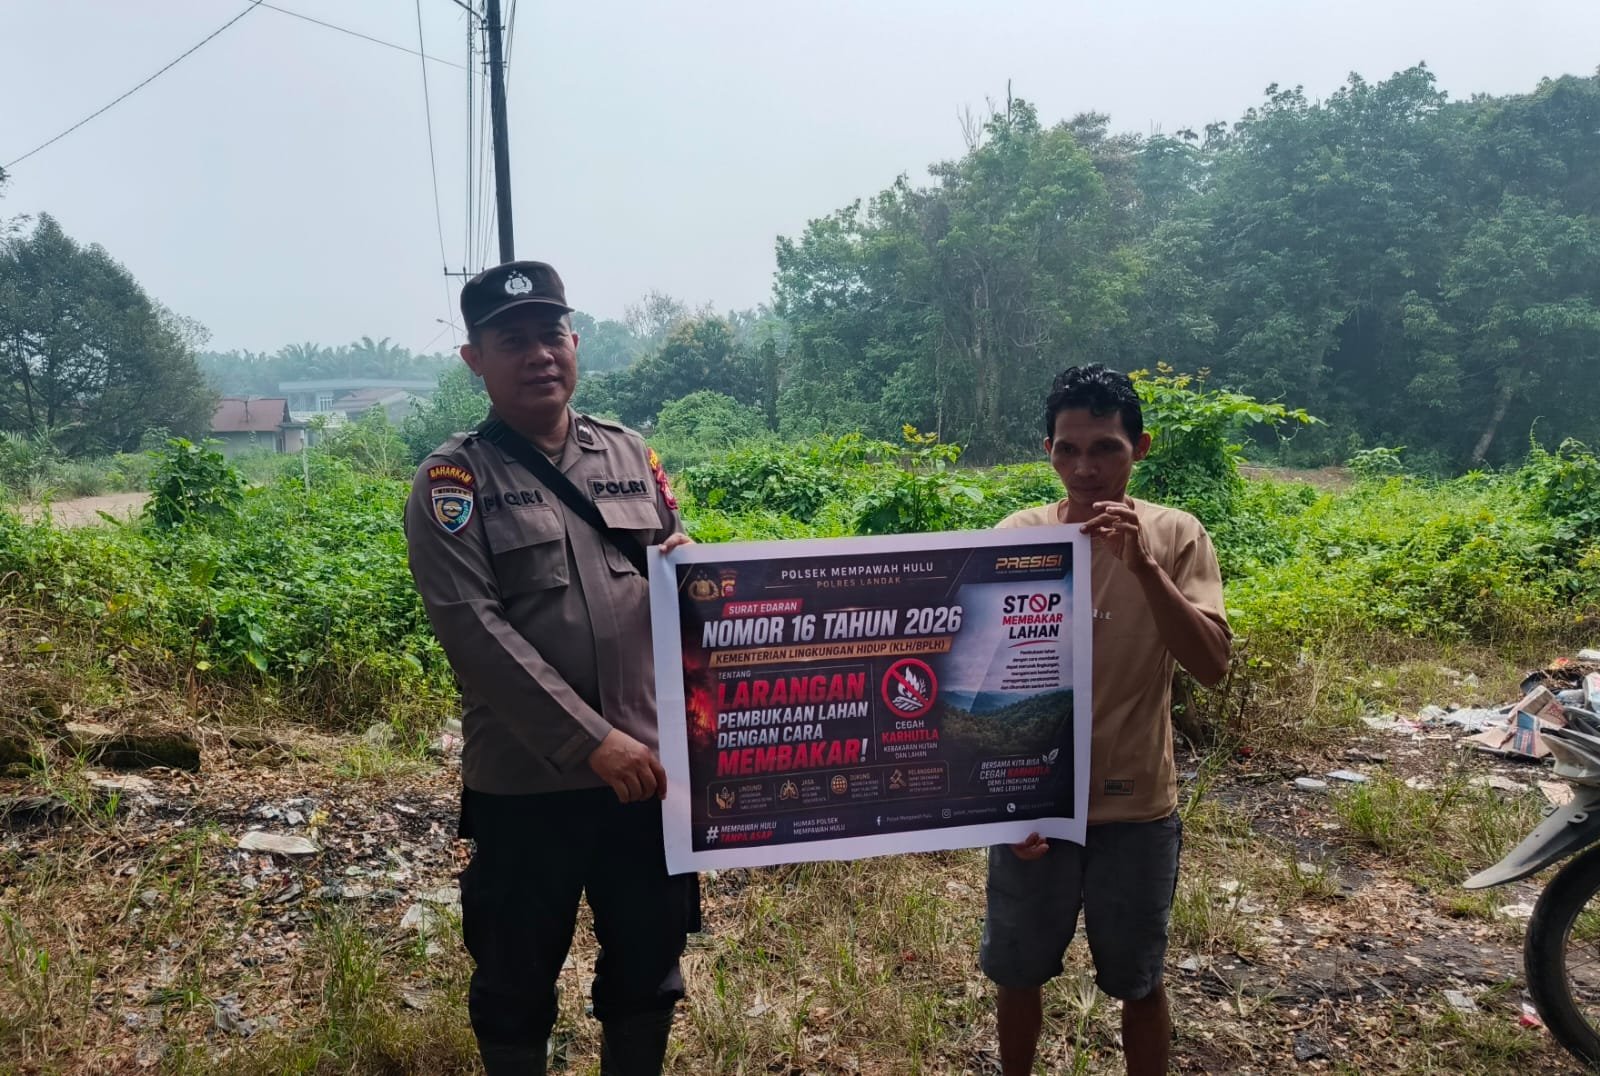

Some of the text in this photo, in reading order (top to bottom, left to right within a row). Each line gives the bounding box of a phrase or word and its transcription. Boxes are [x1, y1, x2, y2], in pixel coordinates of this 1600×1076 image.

[430, 466, 472, 484] BAHARKAM
[593, 480, 648, 495] POLRI
[995, 555, 1063, 570] PRESISI
[781, 562, 934, 580] POLSEK MEMPAWAH HULU
[817, 577, 901, 589] POLRES LANDAK
[729, 602, 797, 614] SURAT EDARAN
[1003, 593, 1062, 614] STOP
[702, 606, 963, 648] NOMOR 16 TAHUN 2026
[1003, 613, 1063, 626] MEMBAKAR
[1009, 624, 1059, 640] LAHAN
[716, 640, 945, 664] KEMENTERIAN LINGKUNGAN HIDUP (KLH/BPLH)
[718, 670, 751, 680] TENTANG
[718, 672, 866, 709] LARANGAN
[718, 701, 869, 729] PEMBUKAAN LAHAN
[895, 720, 925, 730] CEGAH
[718, 724, 823, 749] DENGAN CARA
[881, 729, 940, 744] KARHUTLA
[884, 744, 917, 753] KEBAKARAN
[895, 750, 928, 760] DAN LAHAN
[717, 738, 868, 777] MEMBAKAR!
[981, 760, 1011, 769] BERSAMA
[980, 768, 1006, 780] CEGAH
[759, 821, 777, 830] HULU
[793, 817, 839, 828] HUMAS POLSEK
[793, 825, 829, 835] MEMPAWAH
